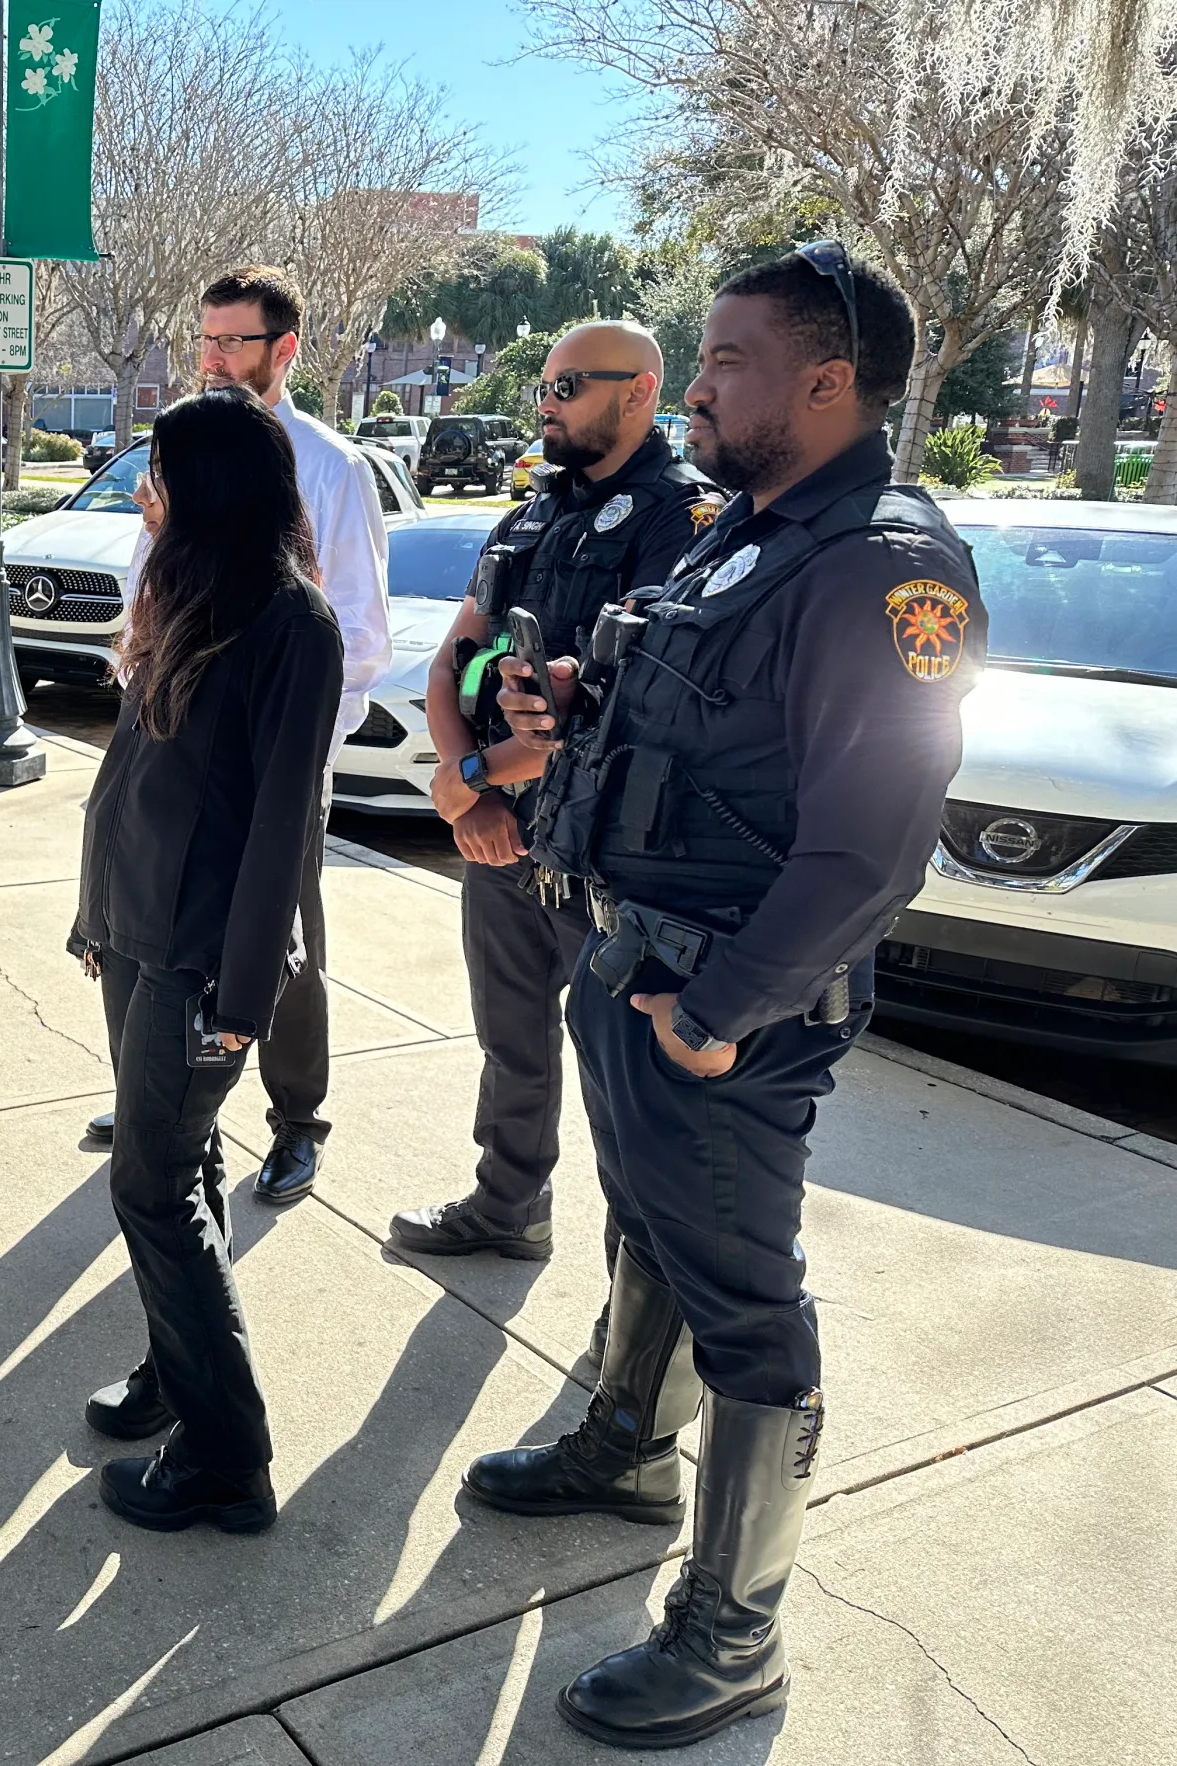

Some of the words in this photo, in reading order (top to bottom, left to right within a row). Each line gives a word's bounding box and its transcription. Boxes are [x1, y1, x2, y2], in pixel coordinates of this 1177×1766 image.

[3, 327, 28, 339] STREET
[9, 344, 27, 357] 8PM
[889, 583, 926, 605] WINTER
[926, 583, 965, 610] GARDEN
[907, 651, 951, 680] POLICE
[985, 833, 1035, 847] NISSAN
